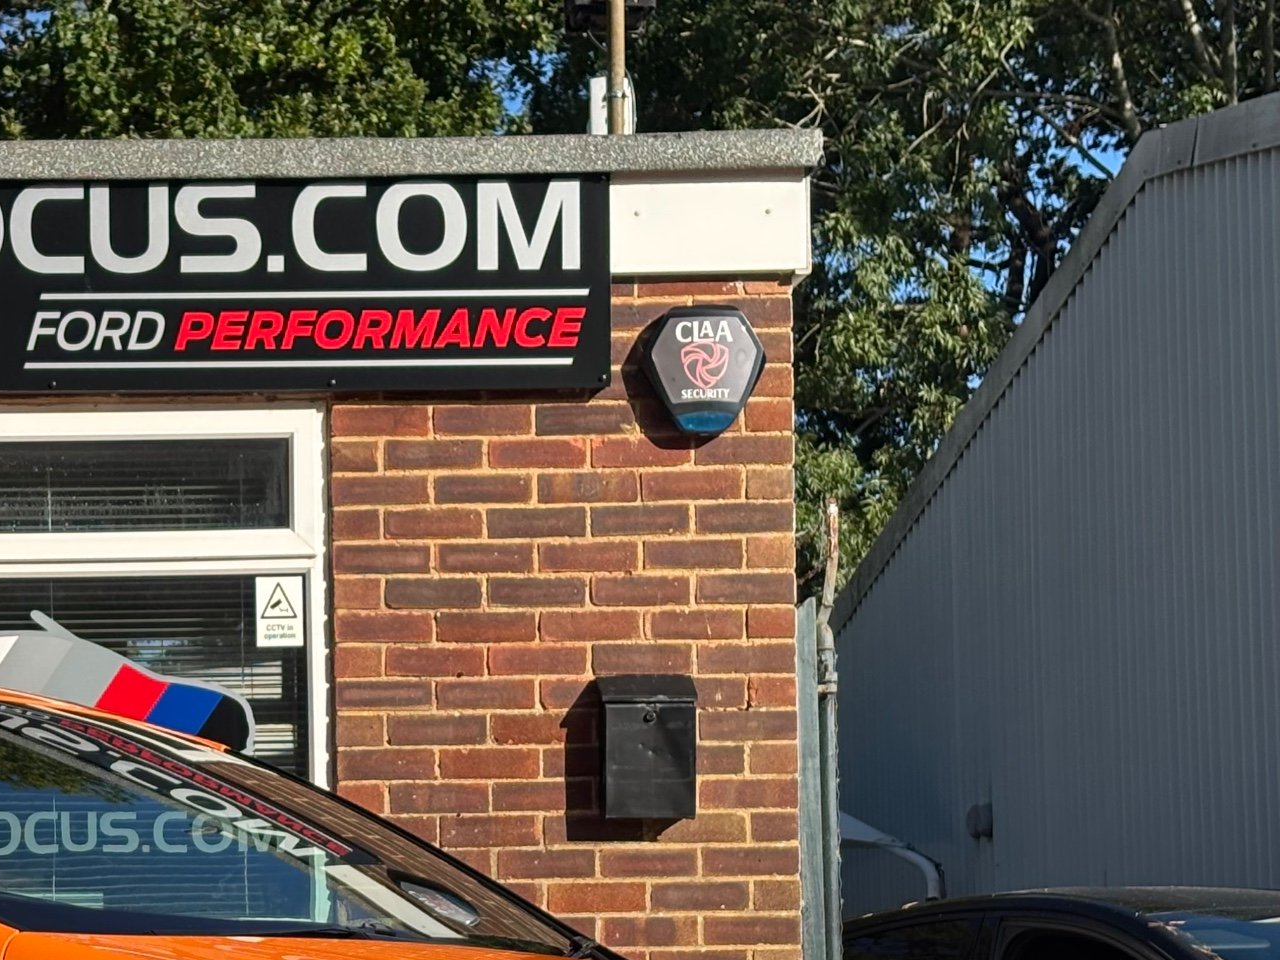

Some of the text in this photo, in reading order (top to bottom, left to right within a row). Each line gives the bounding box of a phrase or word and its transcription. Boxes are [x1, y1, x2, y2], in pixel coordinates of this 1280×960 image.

[26, 306, 587, 352] FORD PERFORMANCE
[675, 320, 734, 343] CLAA
[681, 388, 730, 399] SECURITY
[265, 623, 286, 632] CCTV
[263, 632, 296, 640] operation
